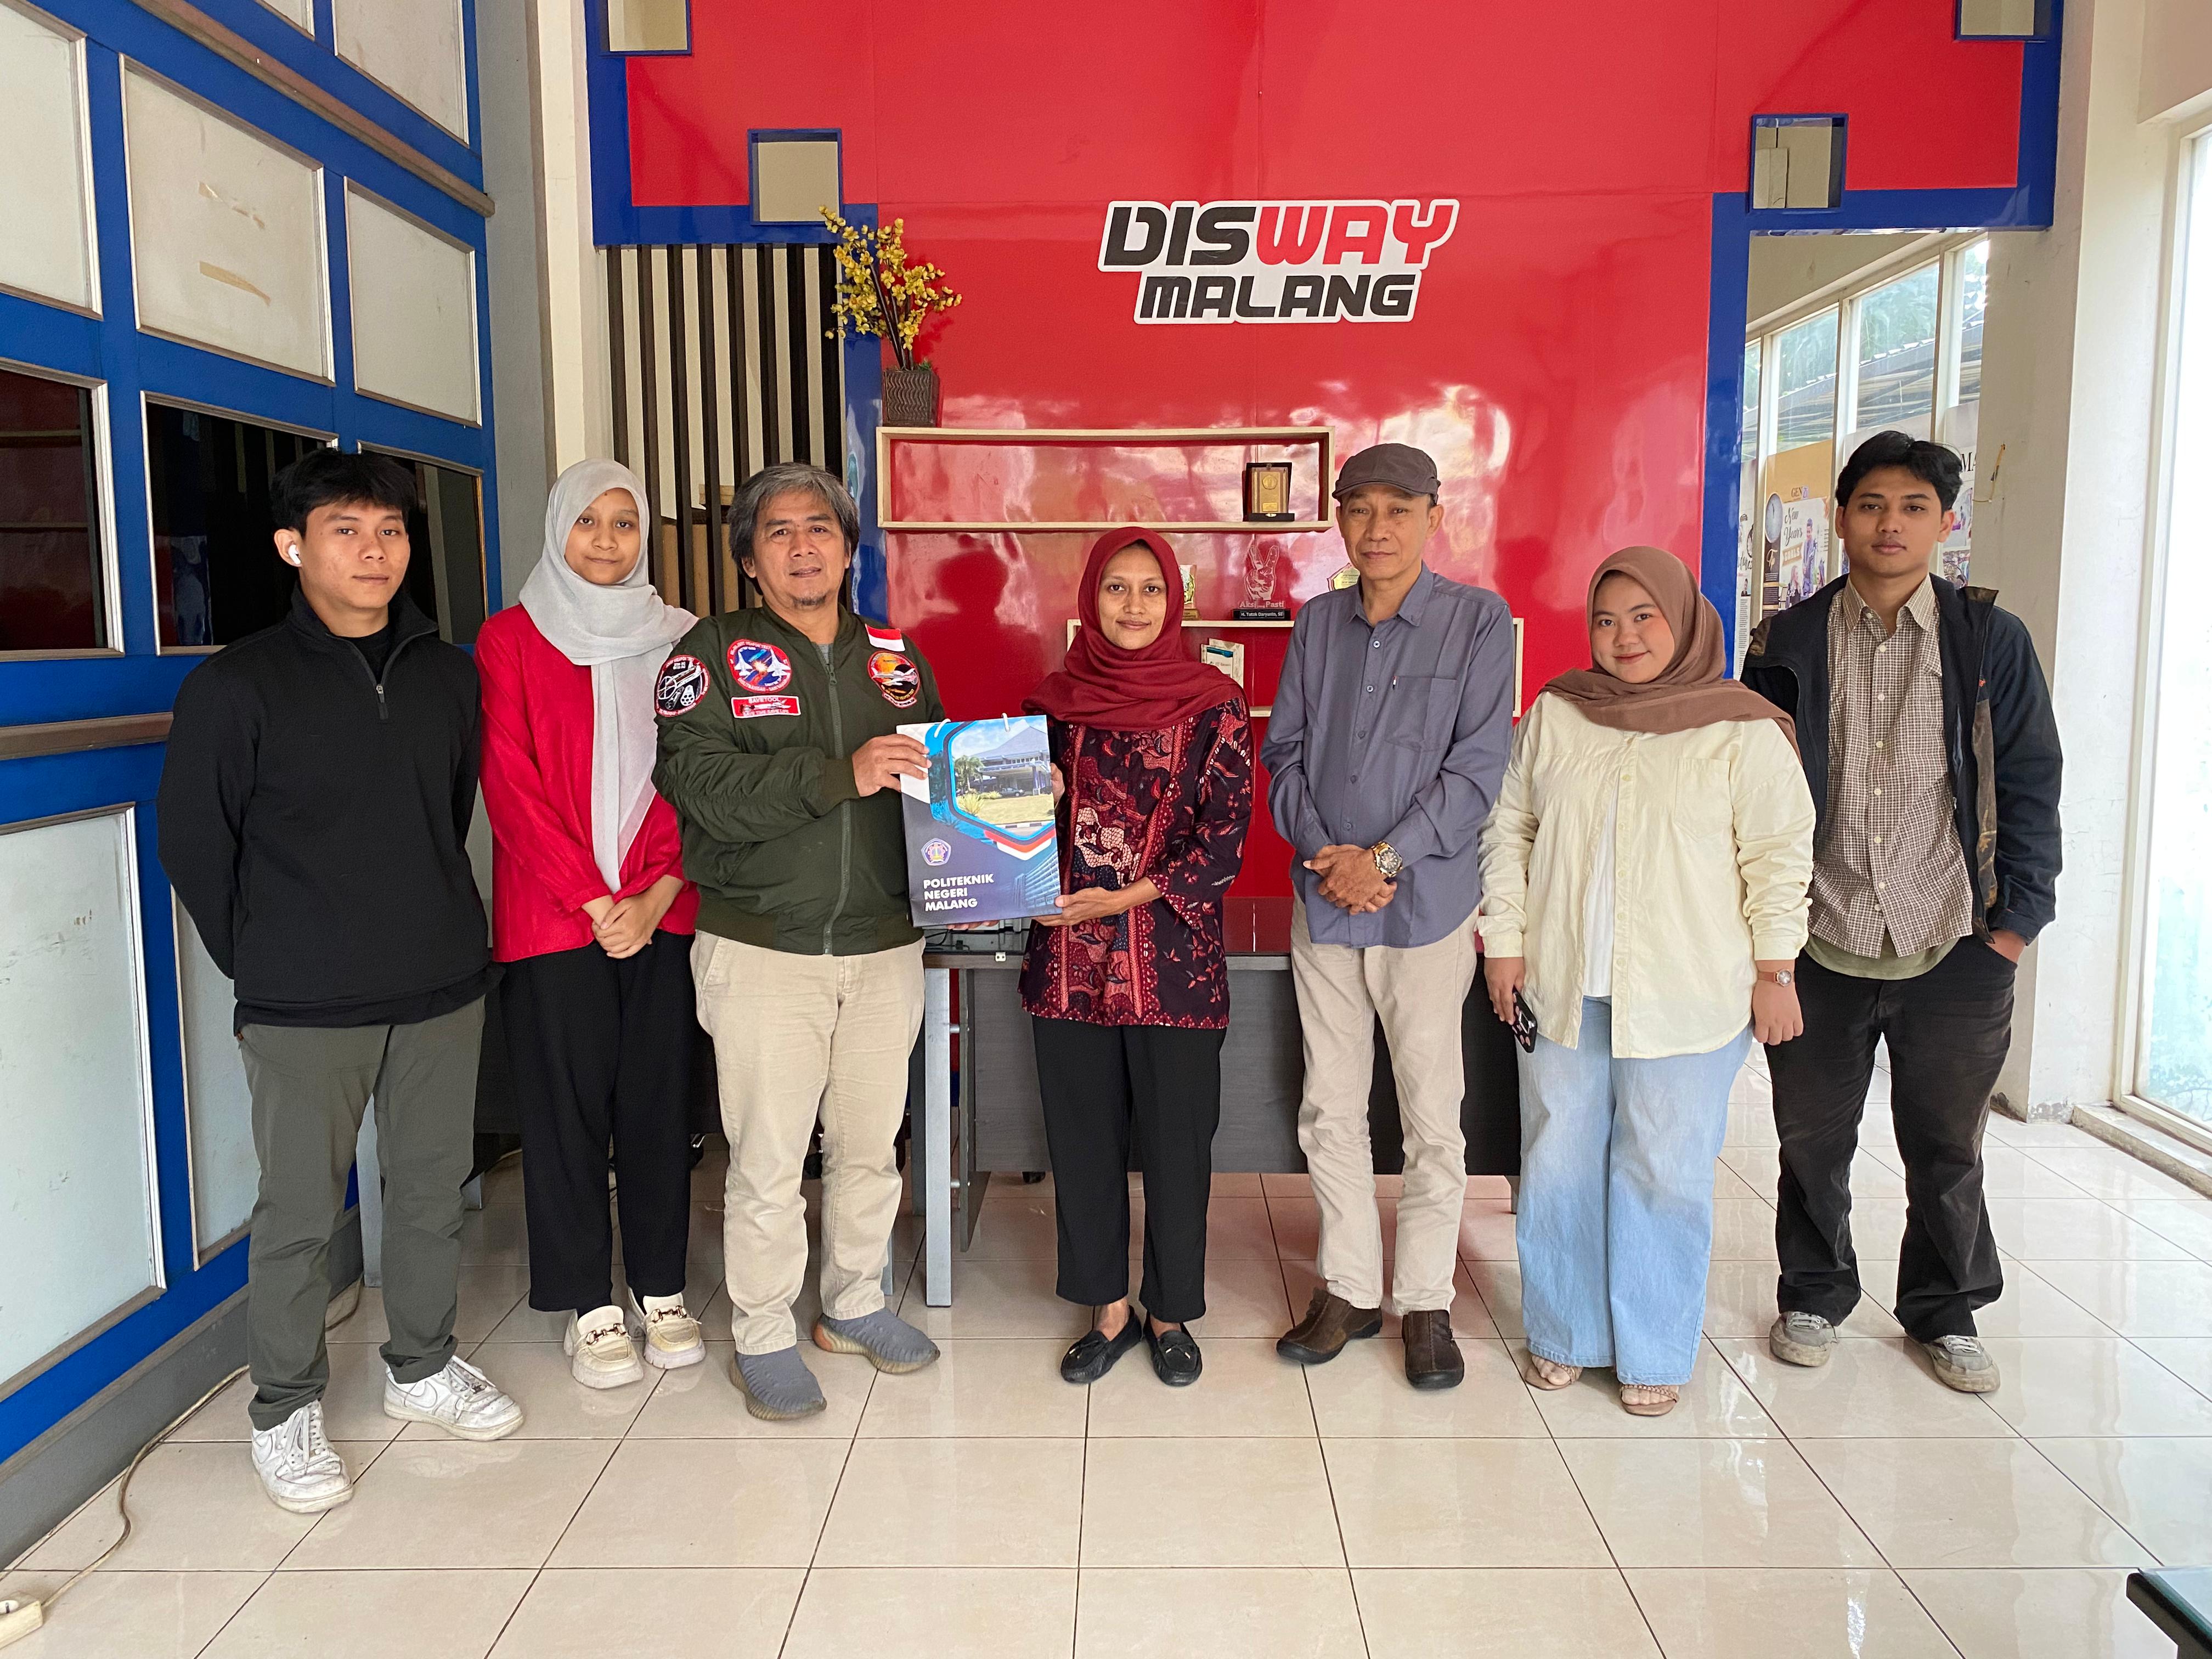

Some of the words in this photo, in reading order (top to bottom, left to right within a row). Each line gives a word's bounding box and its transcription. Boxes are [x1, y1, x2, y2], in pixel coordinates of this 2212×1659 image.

[1103, 205, 1454, 266] DISWAY
[1139, 274, 1416, 318] MALANG
[923, 874, 994, 889] POLITEKNIK
[924, 888, 968, 900] NEGERI
[925, 898, 978, 911] MALANG
